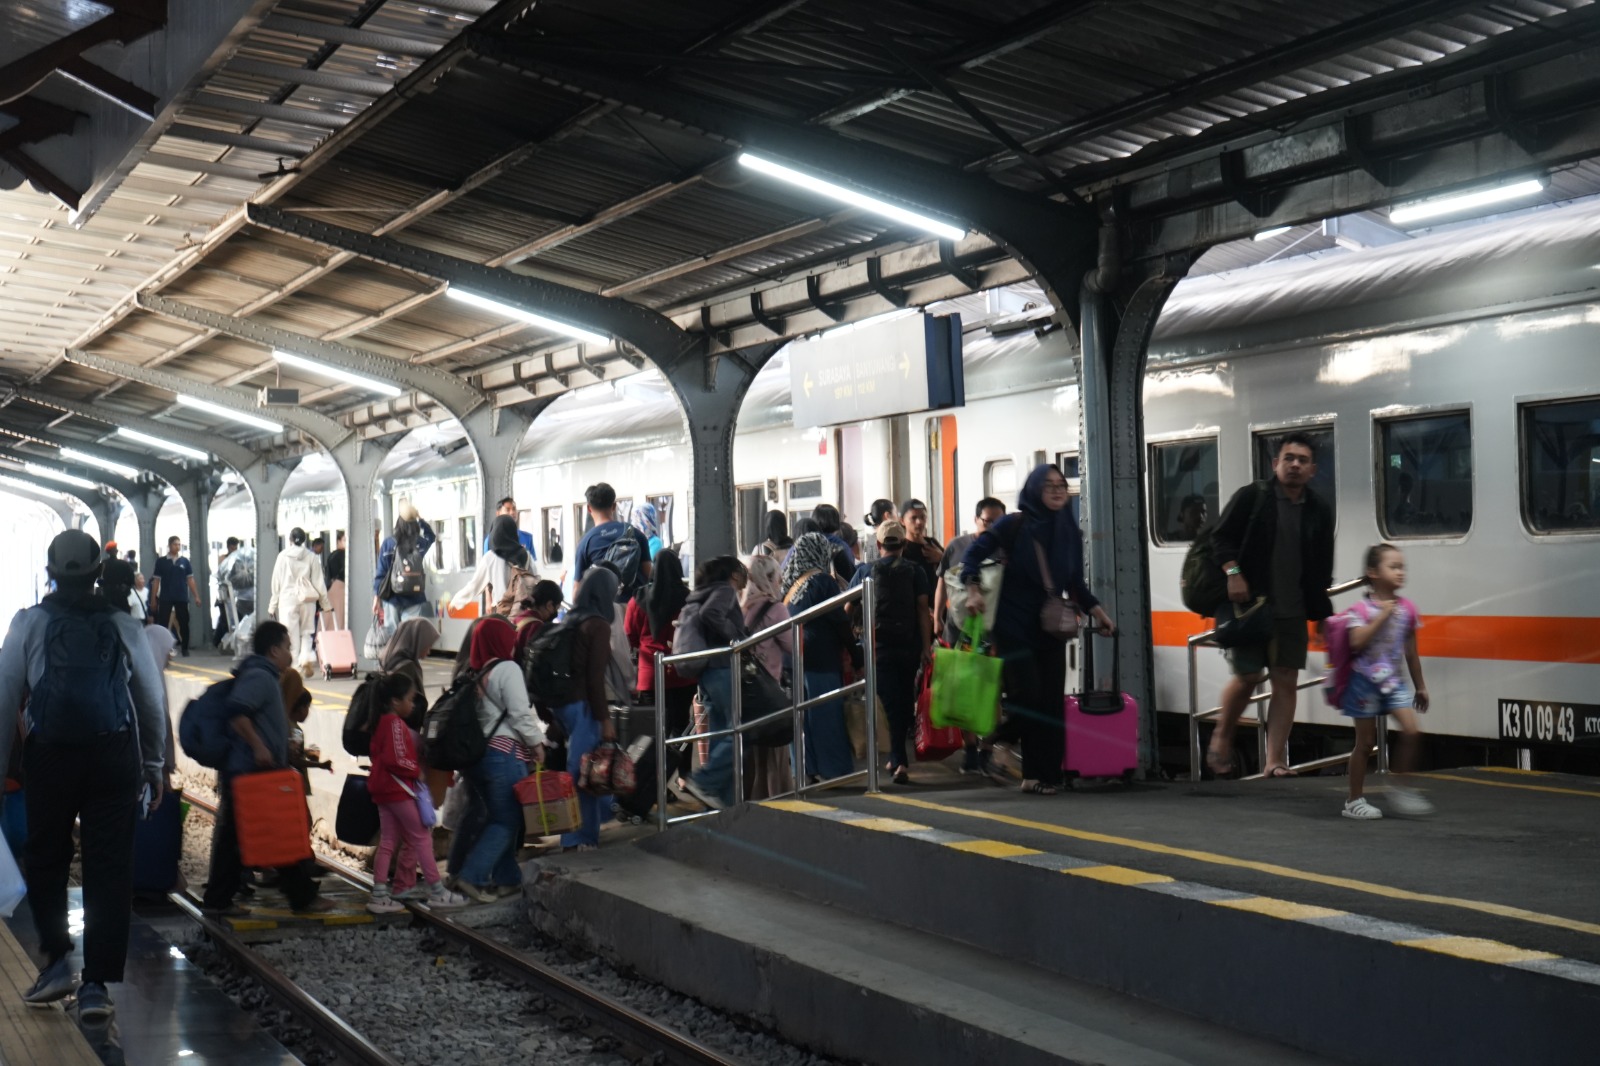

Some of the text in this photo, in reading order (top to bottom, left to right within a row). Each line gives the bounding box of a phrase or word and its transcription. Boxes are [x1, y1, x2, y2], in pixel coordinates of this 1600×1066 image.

[818, 363, 851, 387] SURABAYA
[1502, 703, 1521, 738] K3
[1524, 704, 1533, 739] 0
[1536, 705, 1553, 741] 09
[1557, 706, 1575, 743] 43
